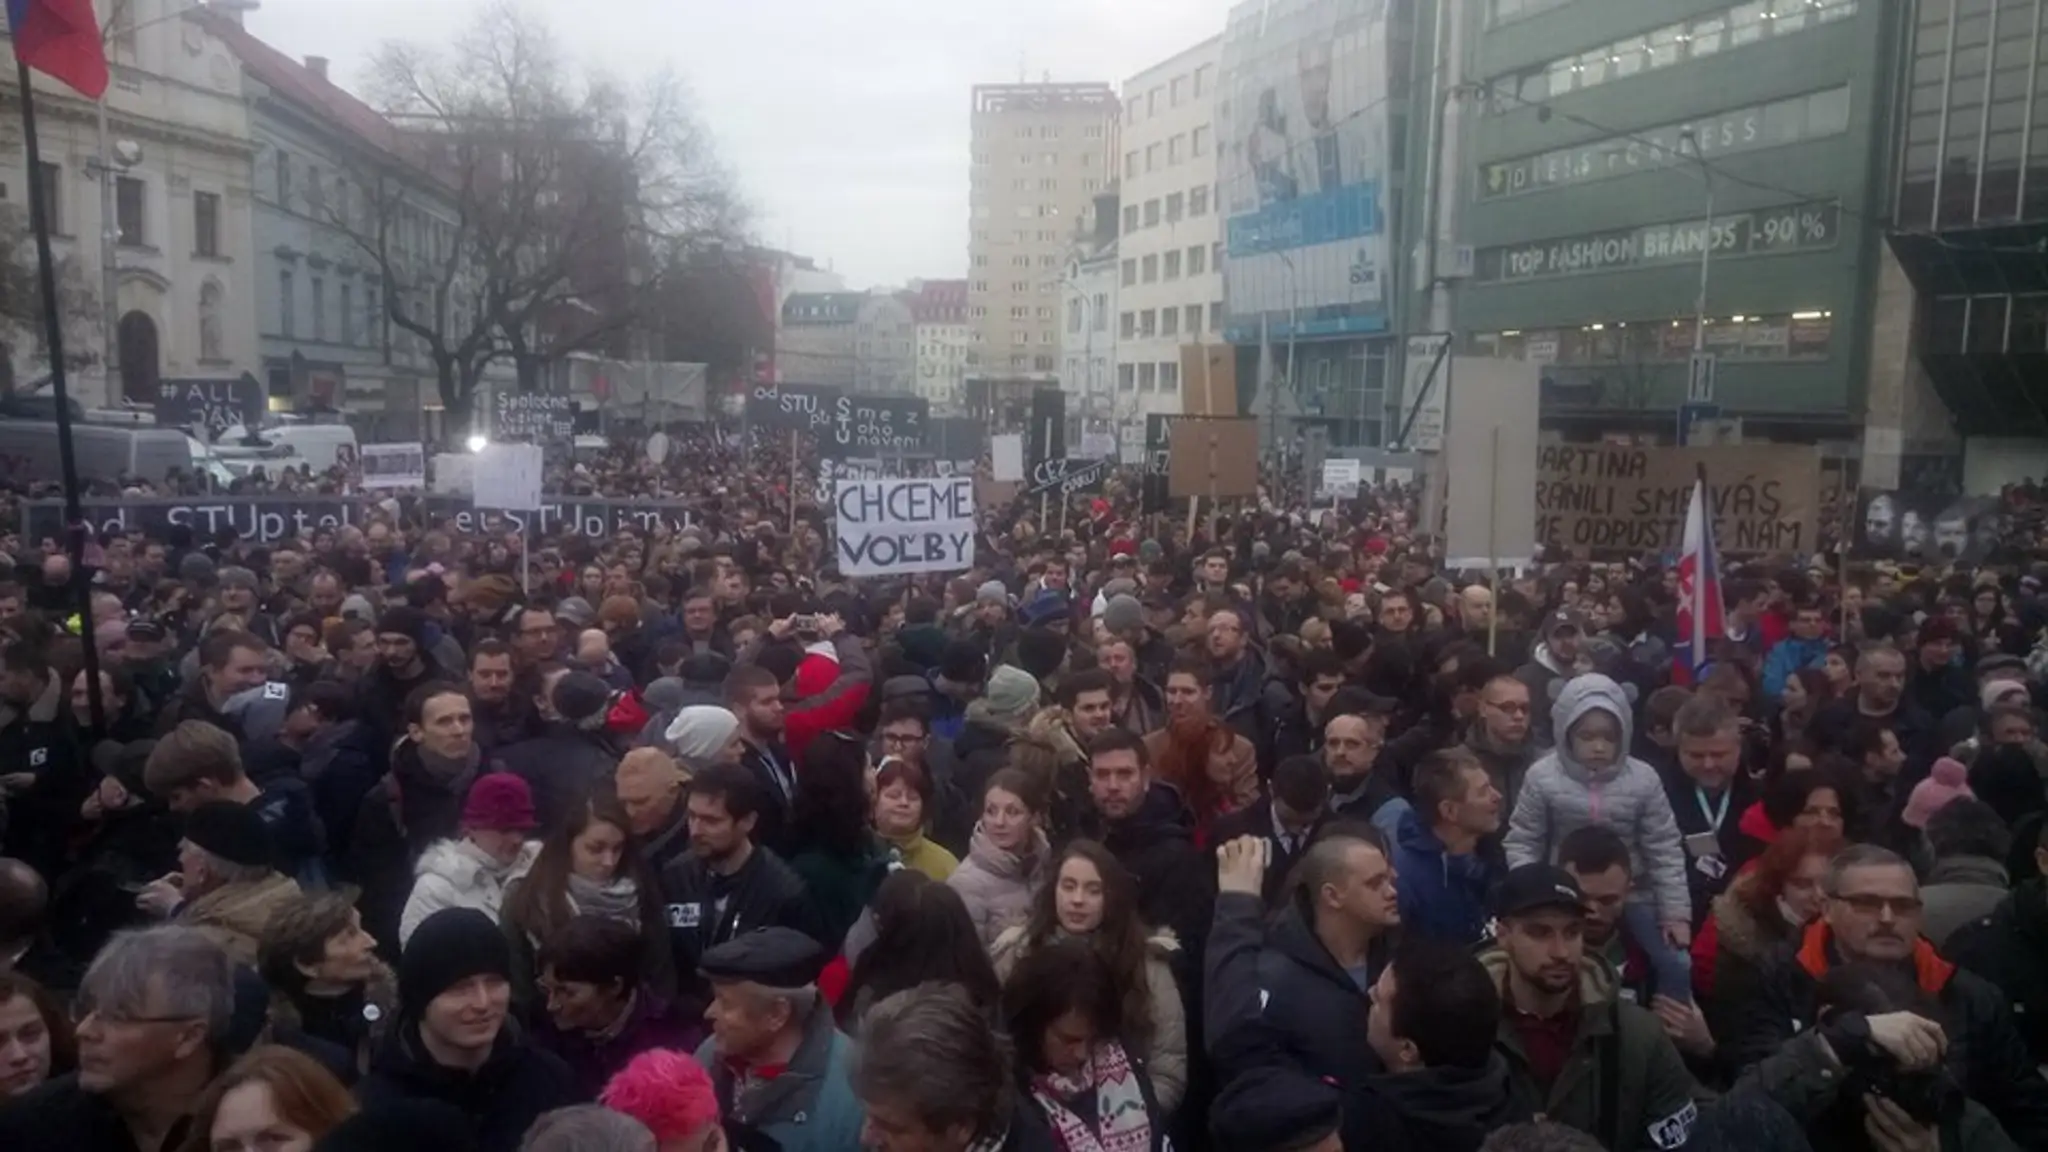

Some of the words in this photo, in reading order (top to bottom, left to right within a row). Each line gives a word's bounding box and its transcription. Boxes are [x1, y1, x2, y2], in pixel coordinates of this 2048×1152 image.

[1511, 249, 1543, 274] TOP
[1548, 236, 1637, 271] FASHION
[1643, 222, 1737, 258] BRANDS
[839, 482, 972, 522] CHCEME
[1536, 475, 1615, 517] RÁNILI
[1631, 487, 1691, 516] SME
[1711, 474, 1780, 516] VÁS
[839, 532, 969, 567] VOĽBY
[1573, 516, 1725, 549] ODPUSTIE
[1735, 514, 1801, 551] NÁM
